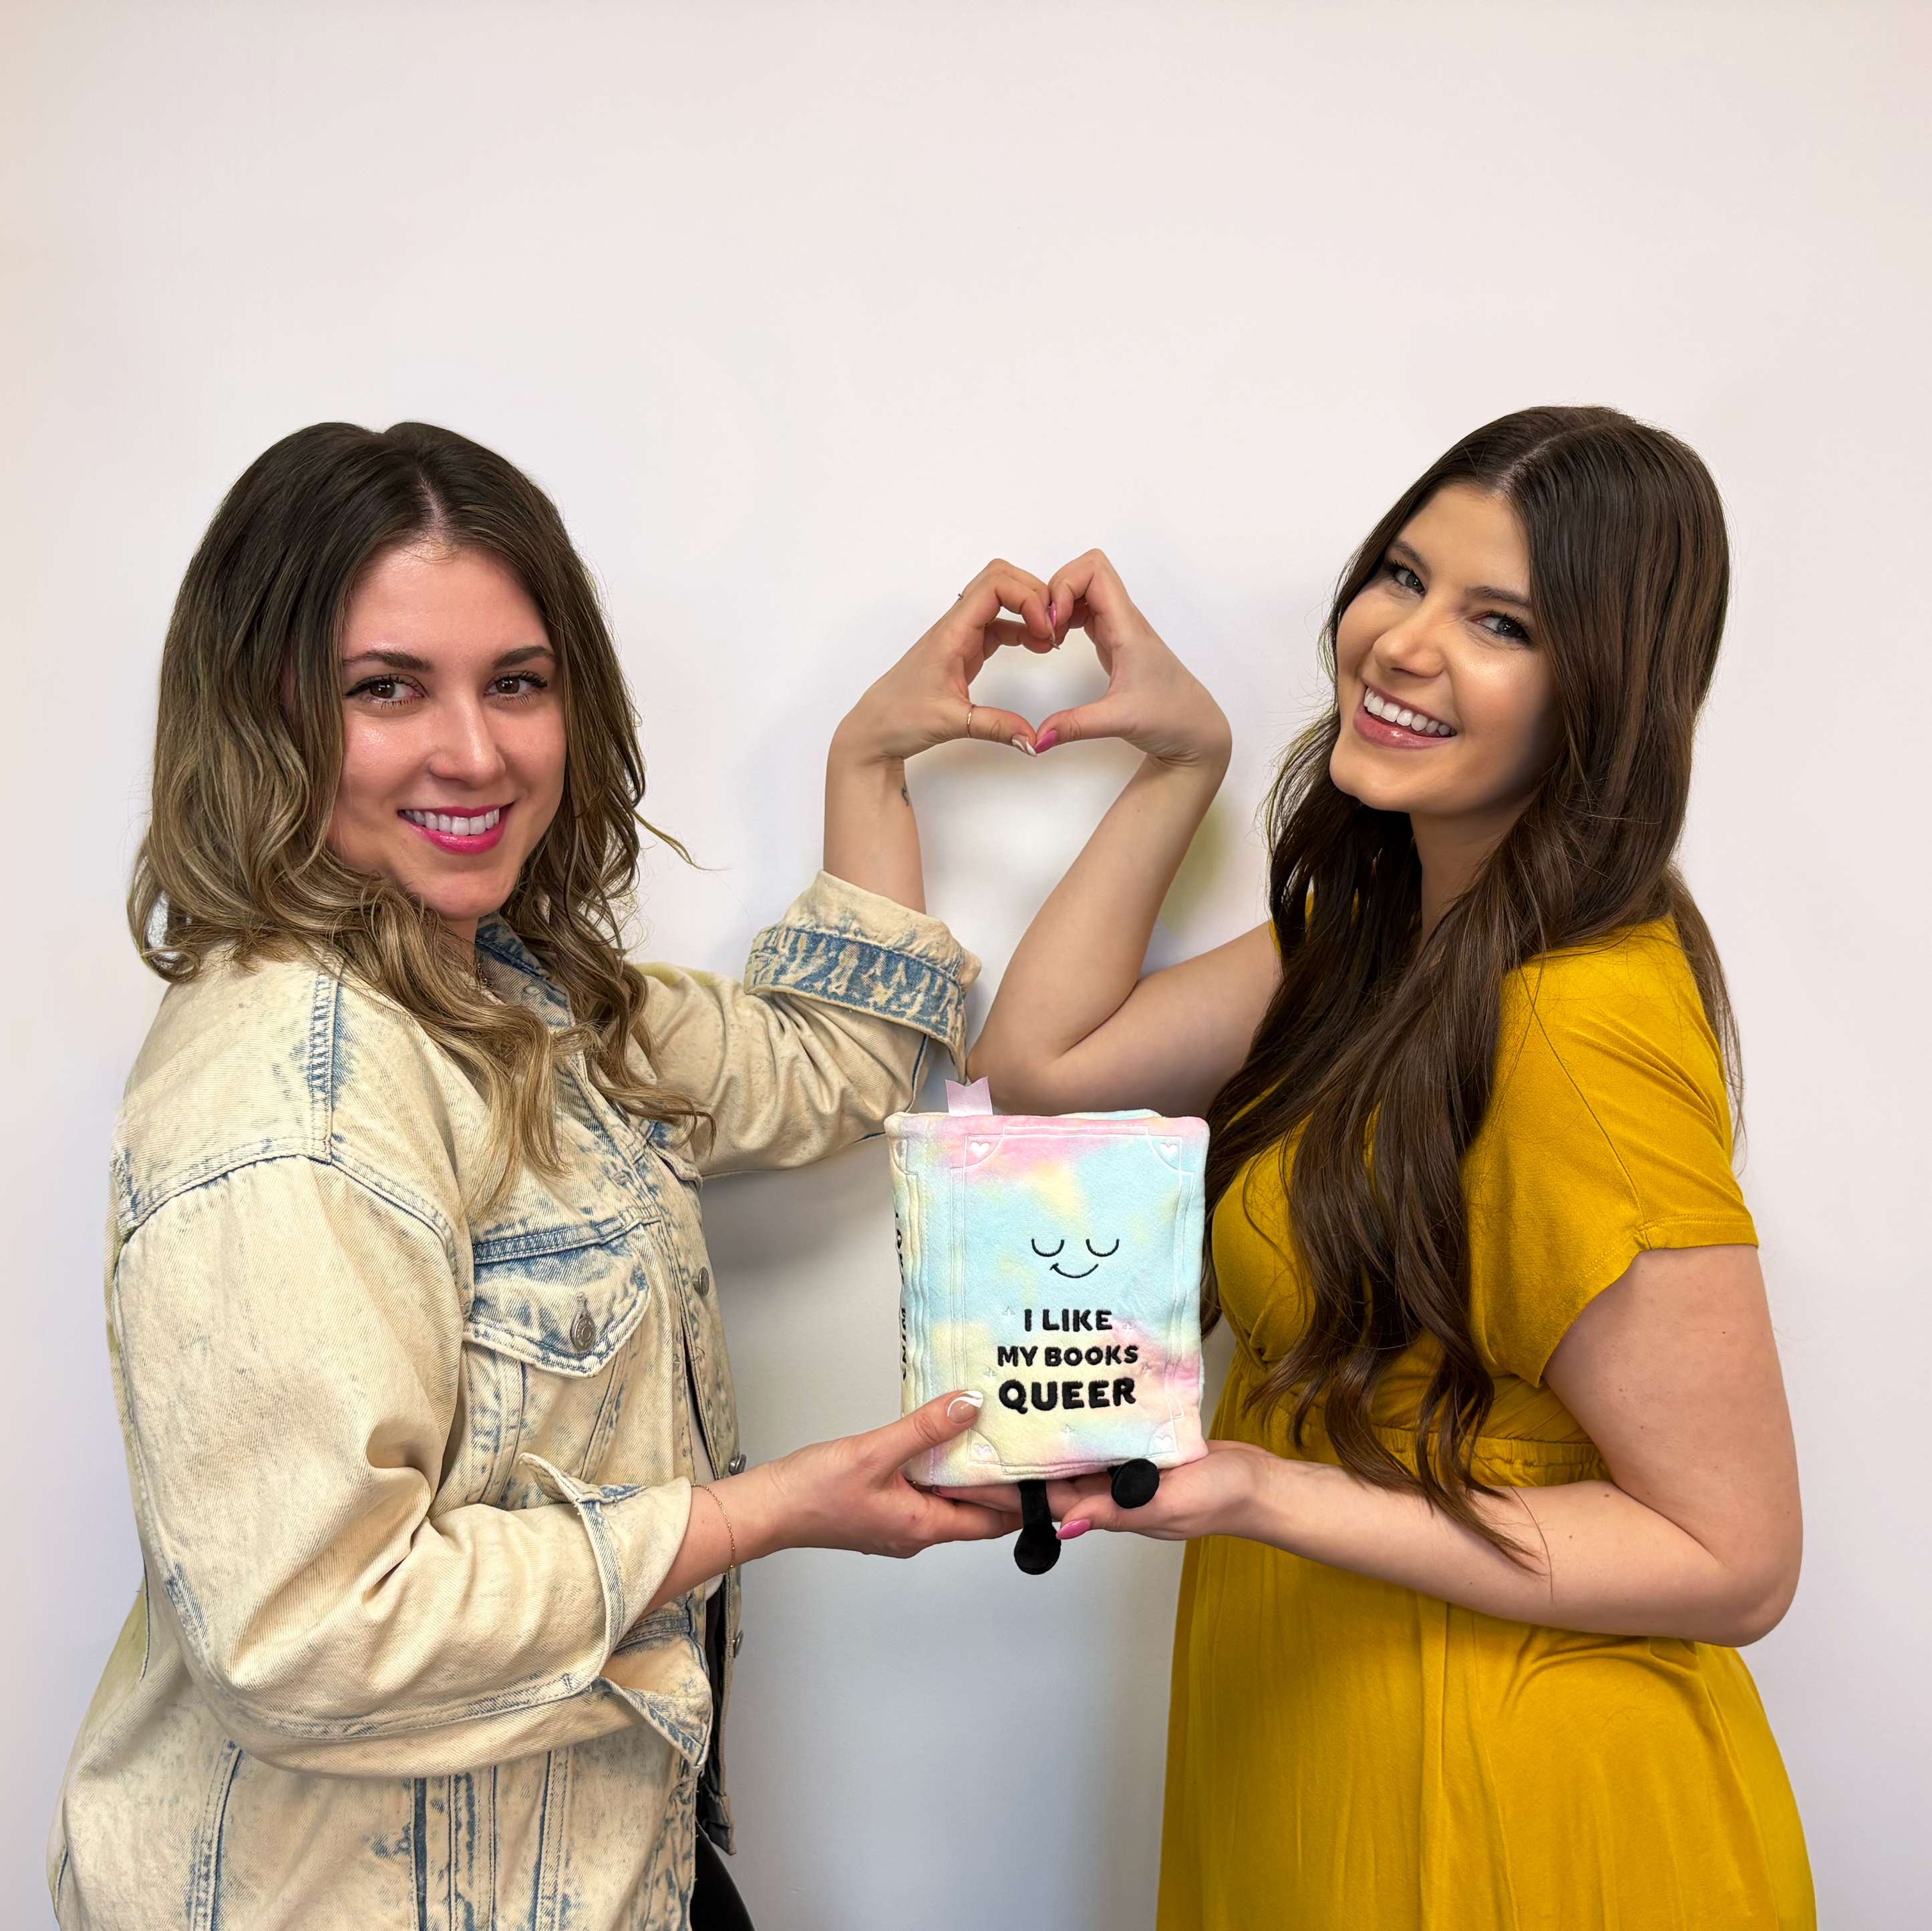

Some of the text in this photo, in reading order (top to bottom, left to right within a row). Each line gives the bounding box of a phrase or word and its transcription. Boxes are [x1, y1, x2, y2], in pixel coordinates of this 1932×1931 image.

[1024, 1308, 1113, 1333] I LIKE
[997, 1345, 1138, 1367] MY BOOKS
[998, 1377, 1136, 1415] QUEER
